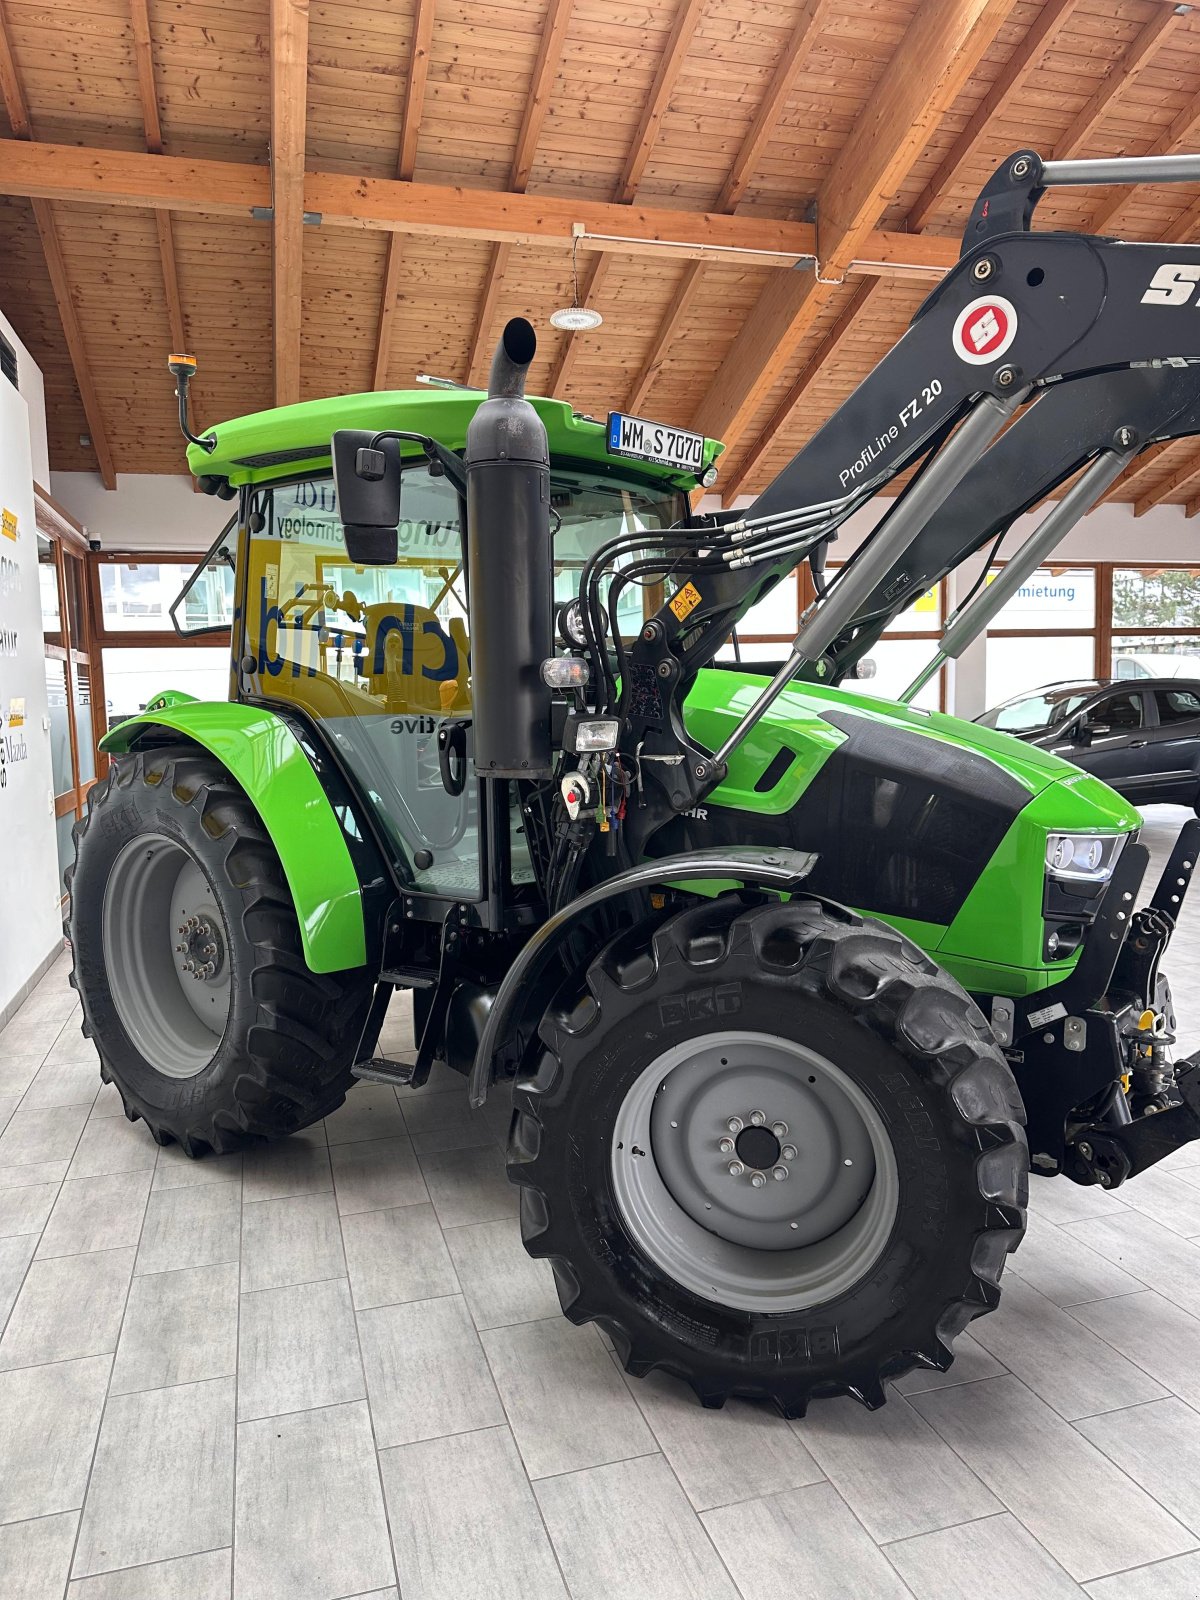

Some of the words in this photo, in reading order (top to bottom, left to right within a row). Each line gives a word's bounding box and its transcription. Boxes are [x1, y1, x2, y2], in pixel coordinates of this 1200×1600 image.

[1140, 264, 1200, 307] S
[622, 420, 644, 450] WM
[653, 428, 664, 455] S
[667, 431, 702, 463] 7070
[839, 425, 899, 488] ProfiLine
[898, 398, 923, 428] FZ
[921, 379, 942, 406] 20
[1014, 584, 1075, 601] mietung
[5, 733, 28, 765] Mazda
[681, 808, 709, 821] HR
[659, 982, 742, 1027] BKT
